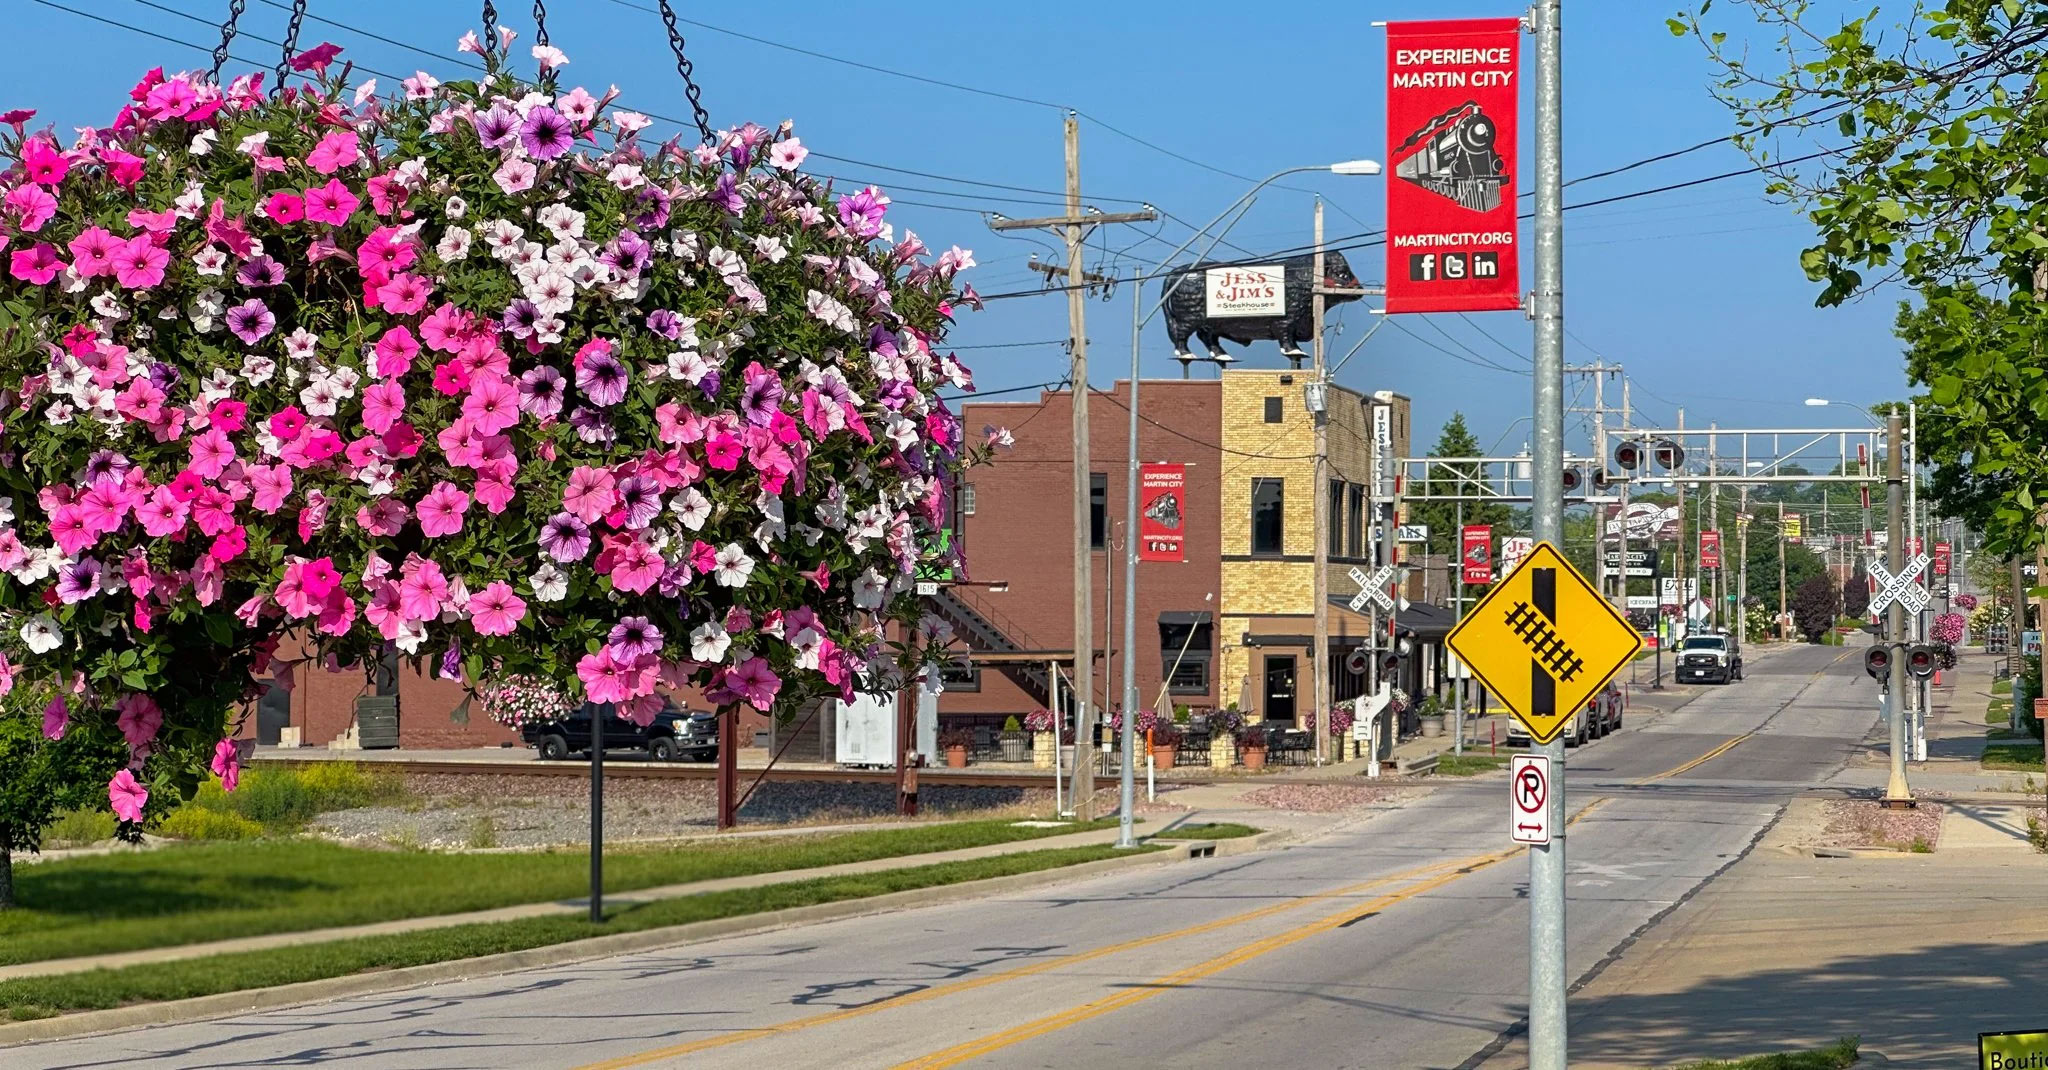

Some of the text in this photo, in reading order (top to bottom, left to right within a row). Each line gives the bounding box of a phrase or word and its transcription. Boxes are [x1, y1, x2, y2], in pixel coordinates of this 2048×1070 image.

[1396, 47, 1511, 66] EXPERIENCE
[1393, 70, 1514, 89] MARTIN CITY
[1394, 231, 1513, 248] MARTINCITY.ORG
[1220, 272, 1266, 287] JESS
[1226, 284, 1275, 302] JIM'S
[1350, 569, 1392, 608] RAIL ROAD
[1351, 567, 1391, 609] CROSSING
[1869, 563, 1920, 613] RAIL ROAD
[1873, 564, 1919, 611] CROSSING
[1991, 1051, 2048, 1070] Bouti
